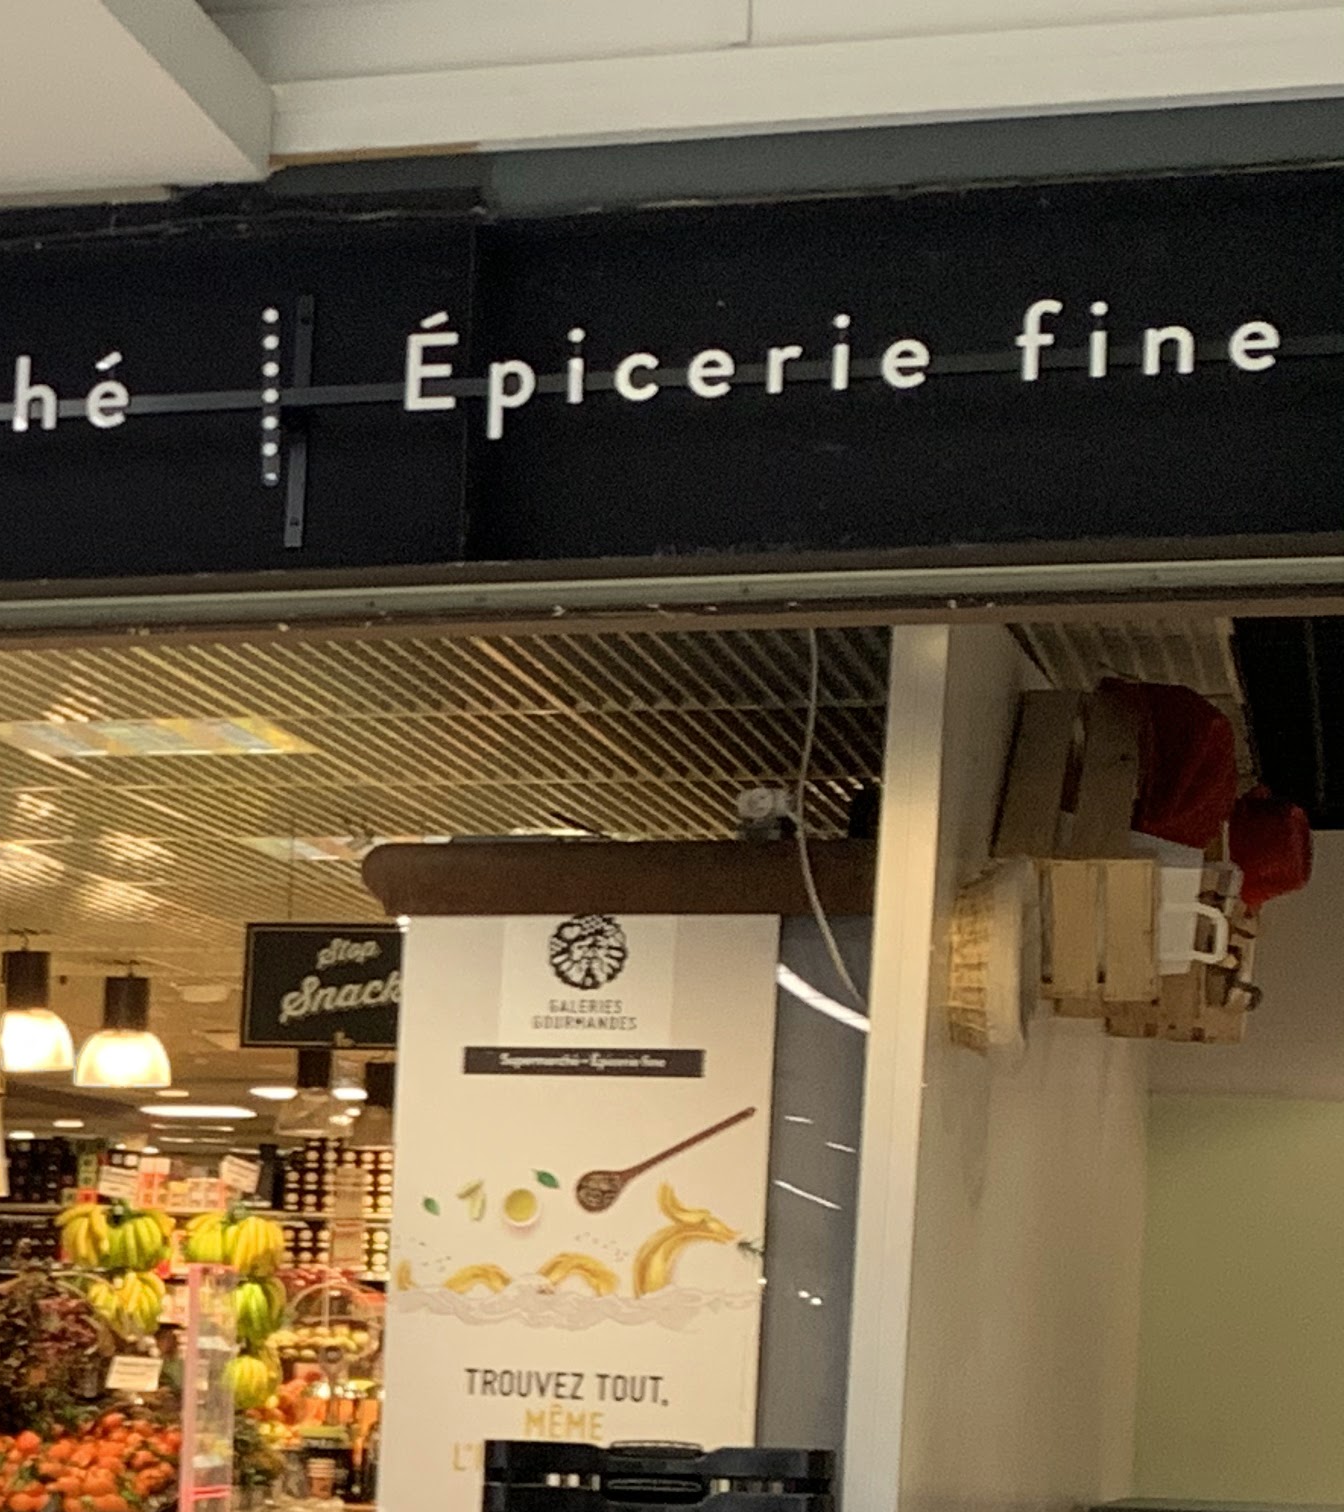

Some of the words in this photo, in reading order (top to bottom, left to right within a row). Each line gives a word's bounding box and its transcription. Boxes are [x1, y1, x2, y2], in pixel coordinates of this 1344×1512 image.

[404, 311, 931, 439] Épicerie
[1015, 299, 1280, 381] fine
[316, 938, 381, 970] Stop
[279, 970, 401, 1025] Snack
[548, 999, 623, 1014] GALERIES
[531, 1015, 637, 1030] GOURMANDES
[464, 1368, 585, 1401] TROUVEZ
[523, 1403, 607, 1441] MÊME
